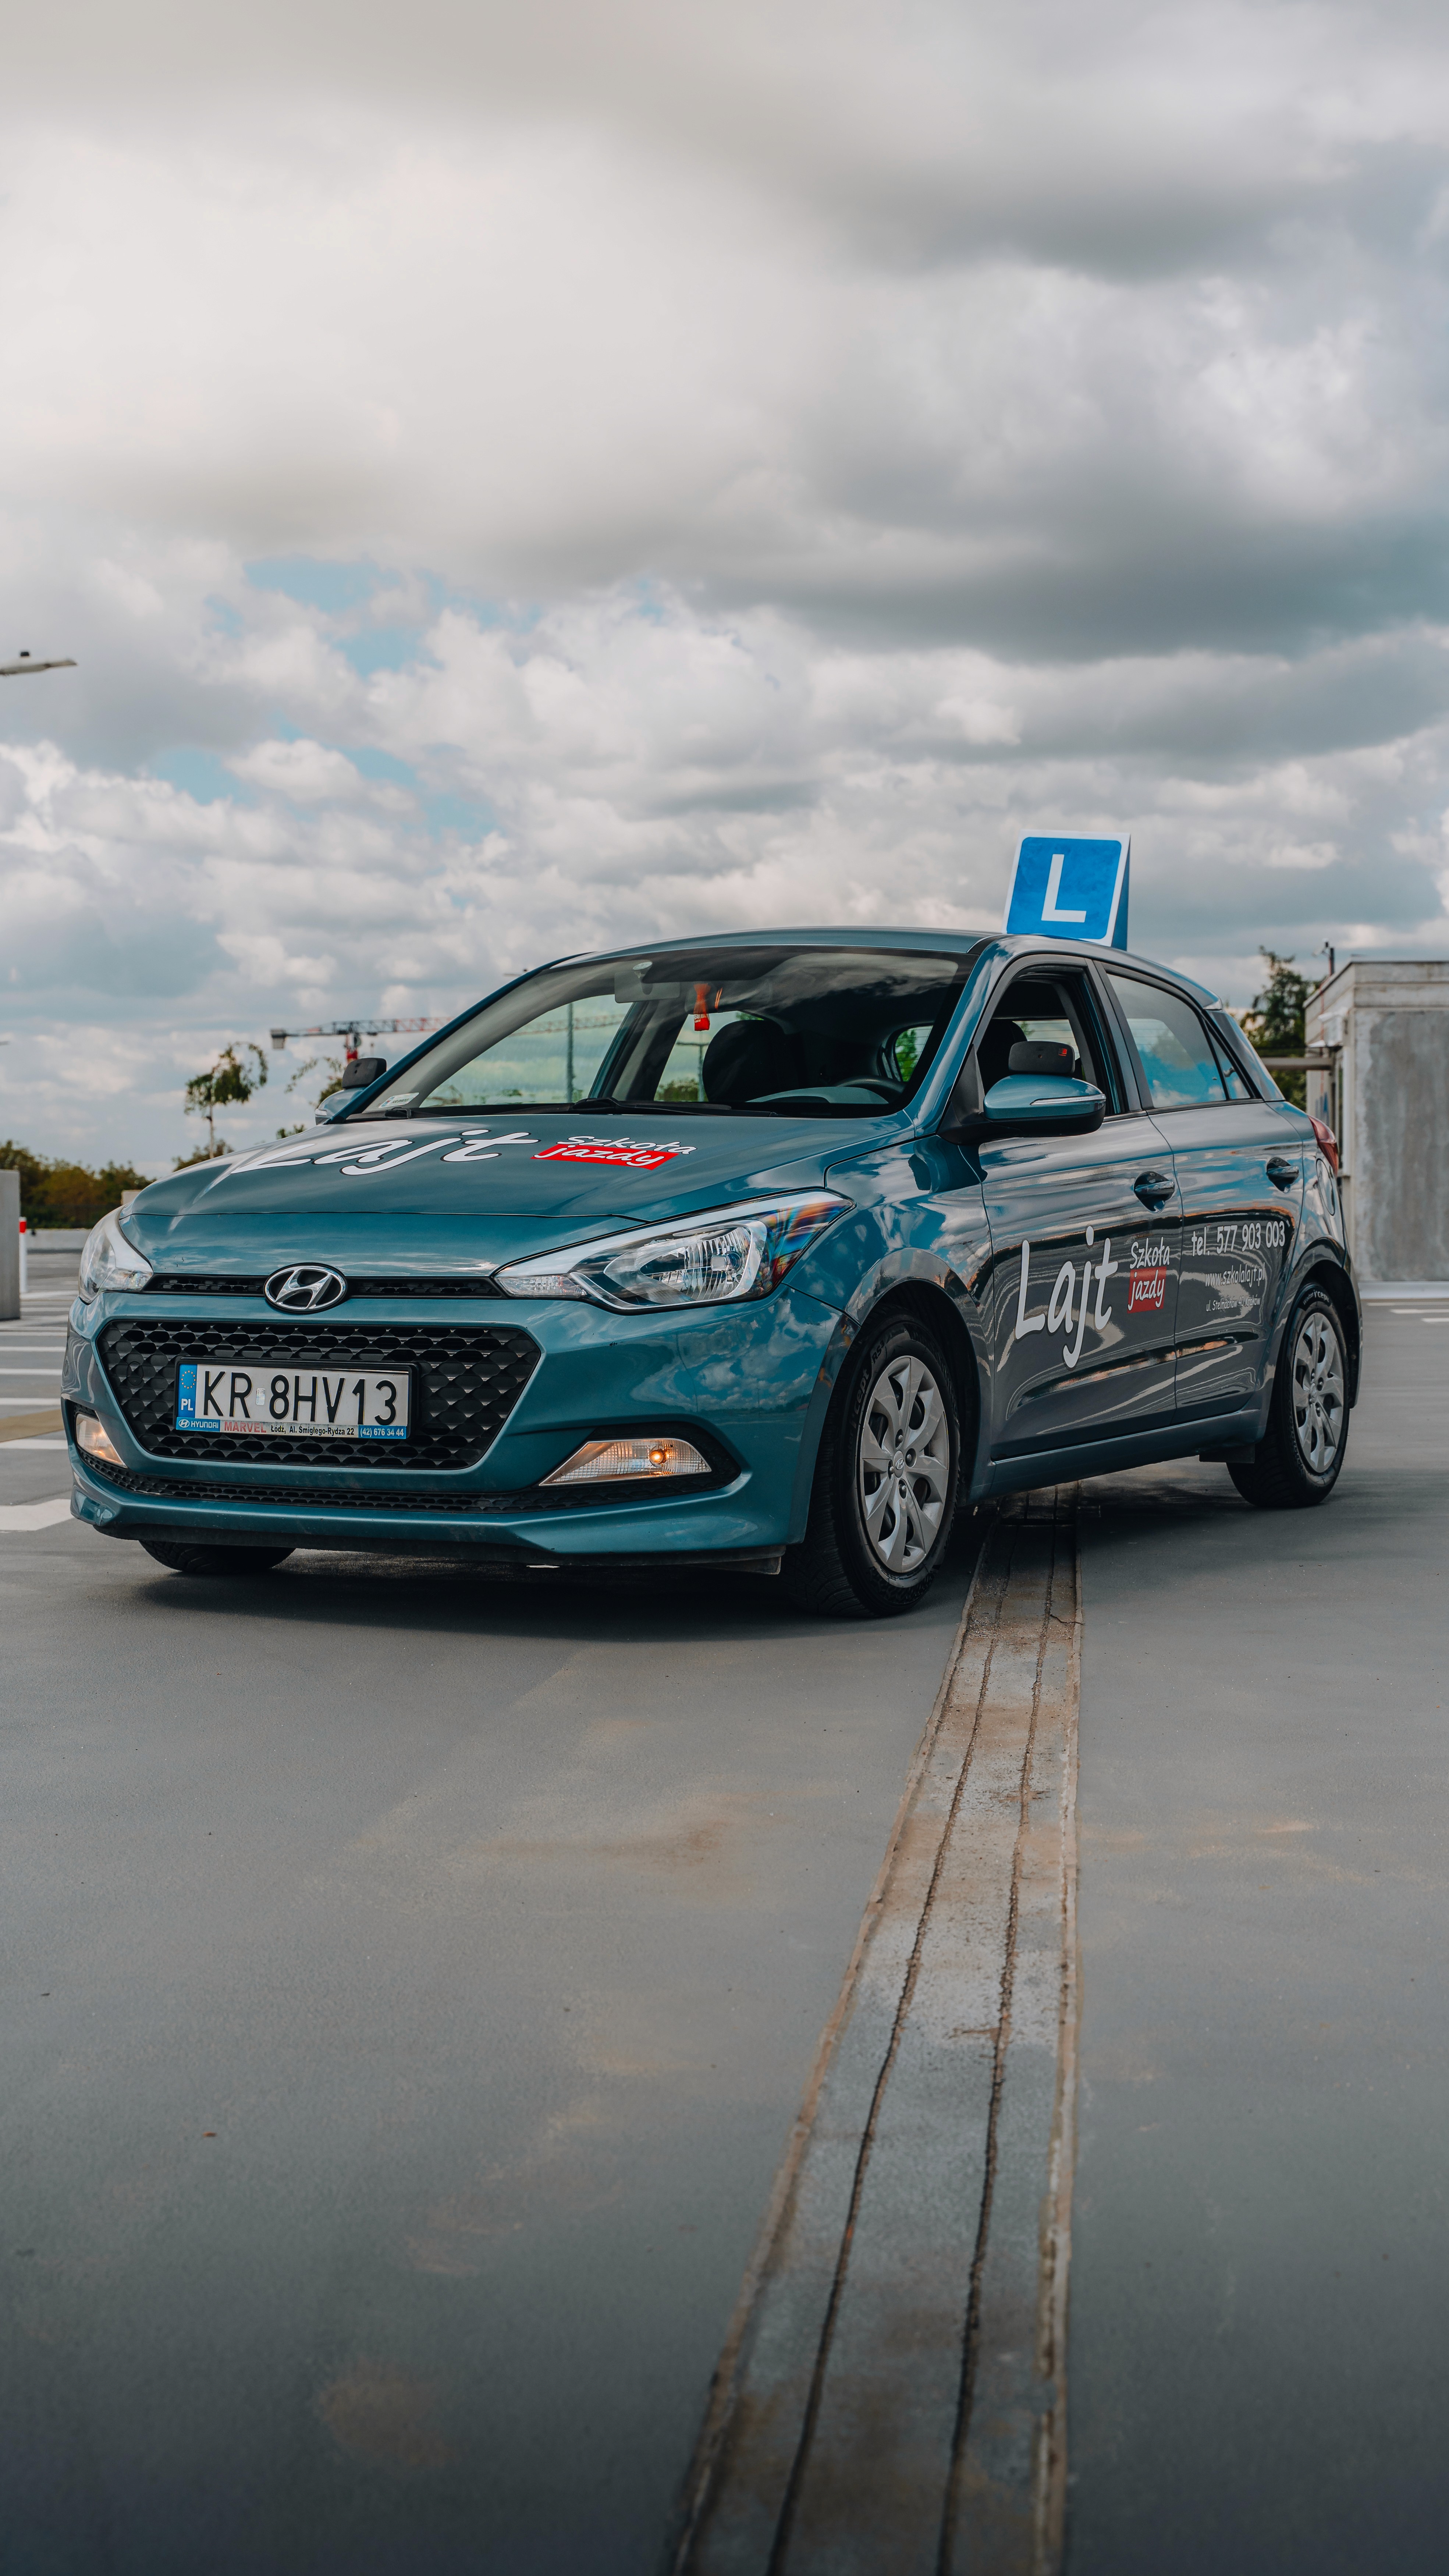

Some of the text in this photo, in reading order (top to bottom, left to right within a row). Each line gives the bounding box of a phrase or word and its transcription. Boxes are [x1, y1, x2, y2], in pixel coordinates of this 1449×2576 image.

[1041, 854, 1087, 923] L
[231, 1129, 541, 1175] Lajt
[533, 1145, 665, 1166] jazdy
[1130, 1236, 1170, 1269] Szkoła
[1191, 1221, 1285, 1256] tel. 577 903 003
[1205, 1262, 1265, 1287] www.szkolalajt.pl
[1015, 1225, 1118, 1368] Lajt
[1128, 1269, 1165, 1310] jazdy
[181, 1398, 193, 1411] PL
[203, 1370, 397, 1426] KR 8HV13
[191, 1420, 219, 1429] HYUNDAI
[224, 1421, 267, 1433] MARVEL
[271, 1425, 286, 1434] Łódź,
[299, 1424, 345, 1436] Śmigłego-Rydza
[360, 1425, 372, 1437] (42)
[374, 1428, 385, 1436] 676
